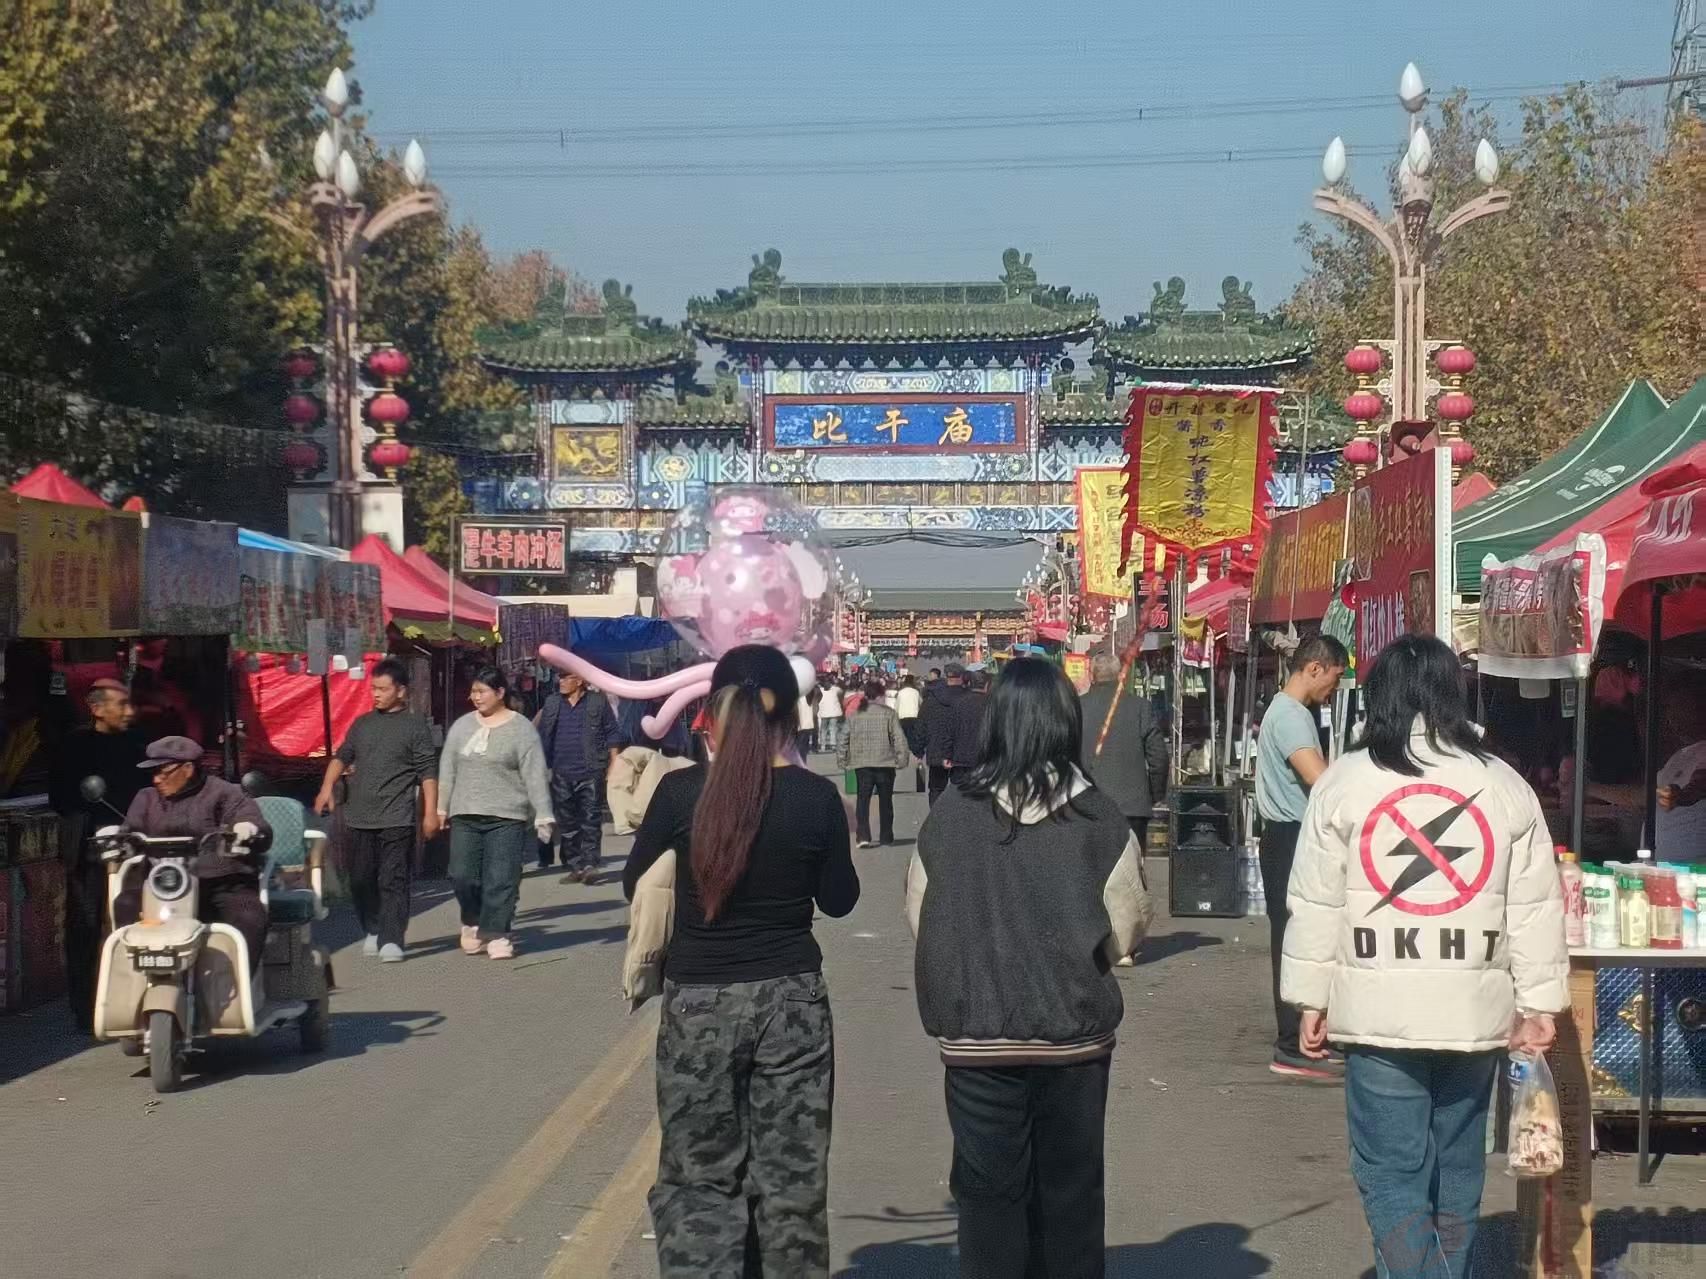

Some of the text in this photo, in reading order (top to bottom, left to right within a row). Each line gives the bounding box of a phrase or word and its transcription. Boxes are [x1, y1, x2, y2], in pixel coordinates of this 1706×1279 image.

[812, 408, 974, 446] 比干庙
[1353, 927, 1501, 962] DKHT
